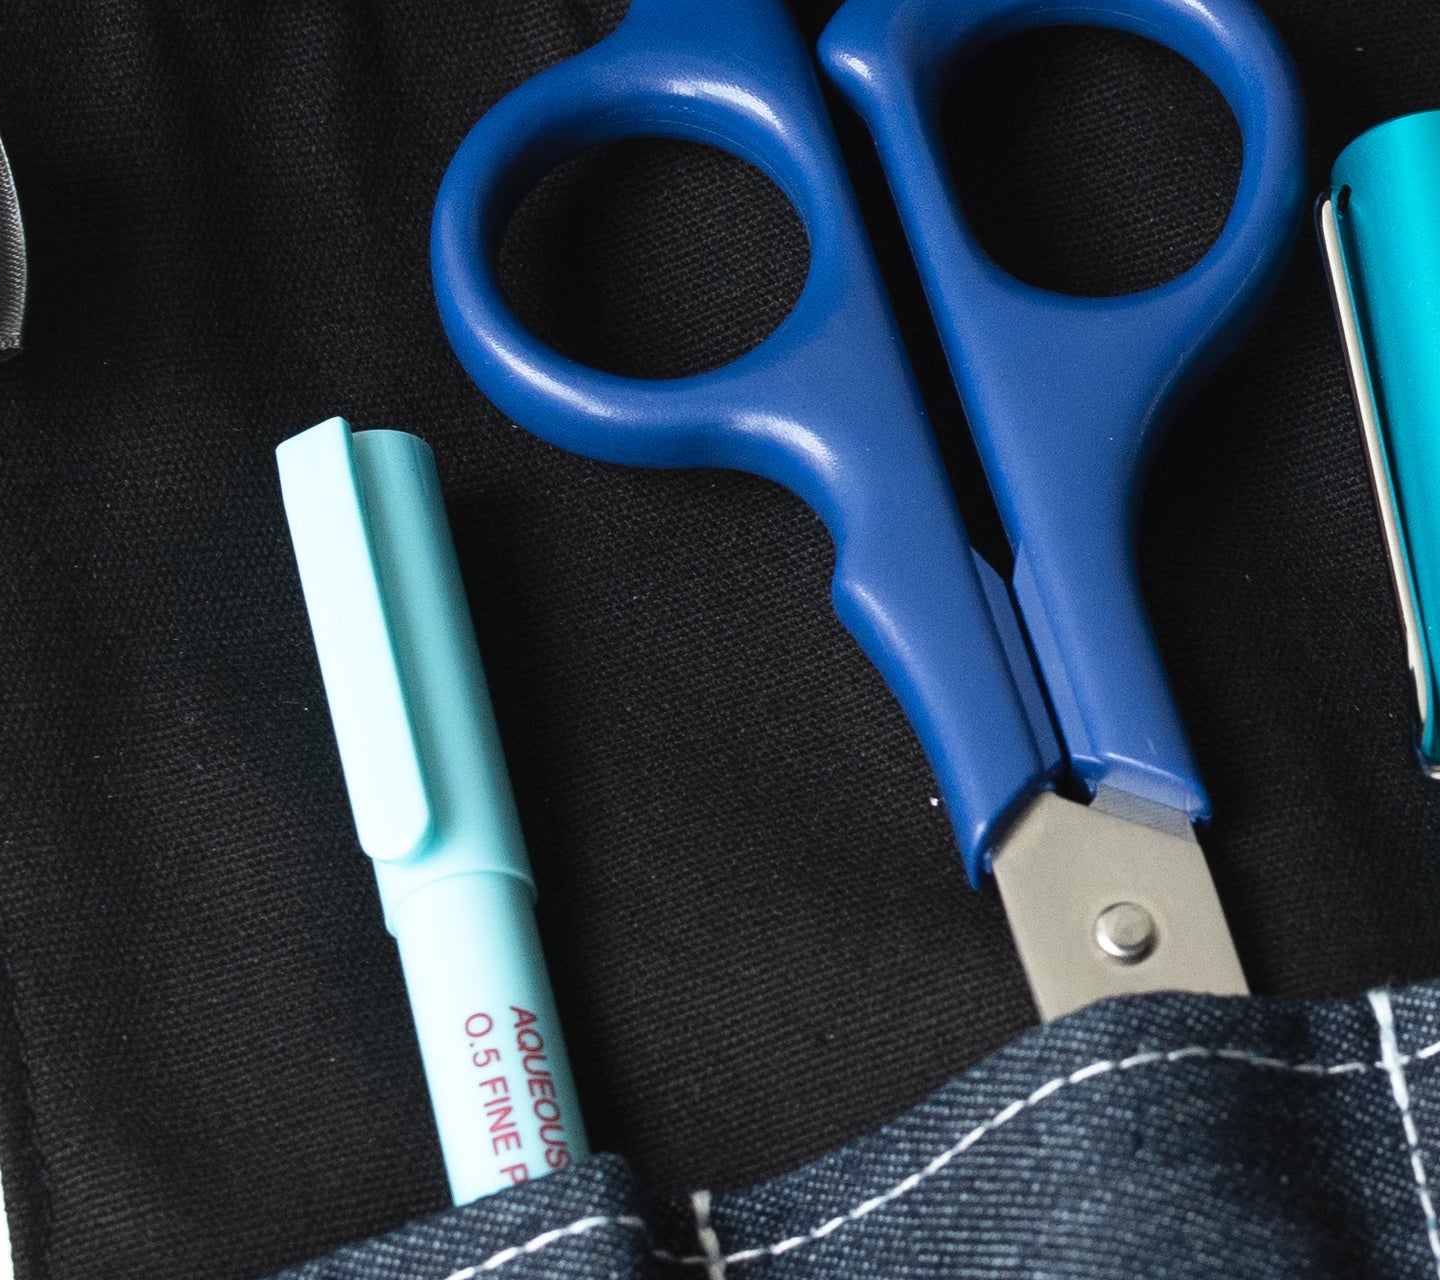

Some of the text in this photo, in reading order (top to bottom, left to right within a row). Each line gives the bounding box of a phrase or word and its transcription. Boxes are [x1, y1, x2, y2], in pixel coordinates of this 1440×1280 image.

[464, 1012, 501, 1067] 0.5
[479, 1076, 522, 1156] FINE
[509, 1005, 573, 1169] AQUEOUS
